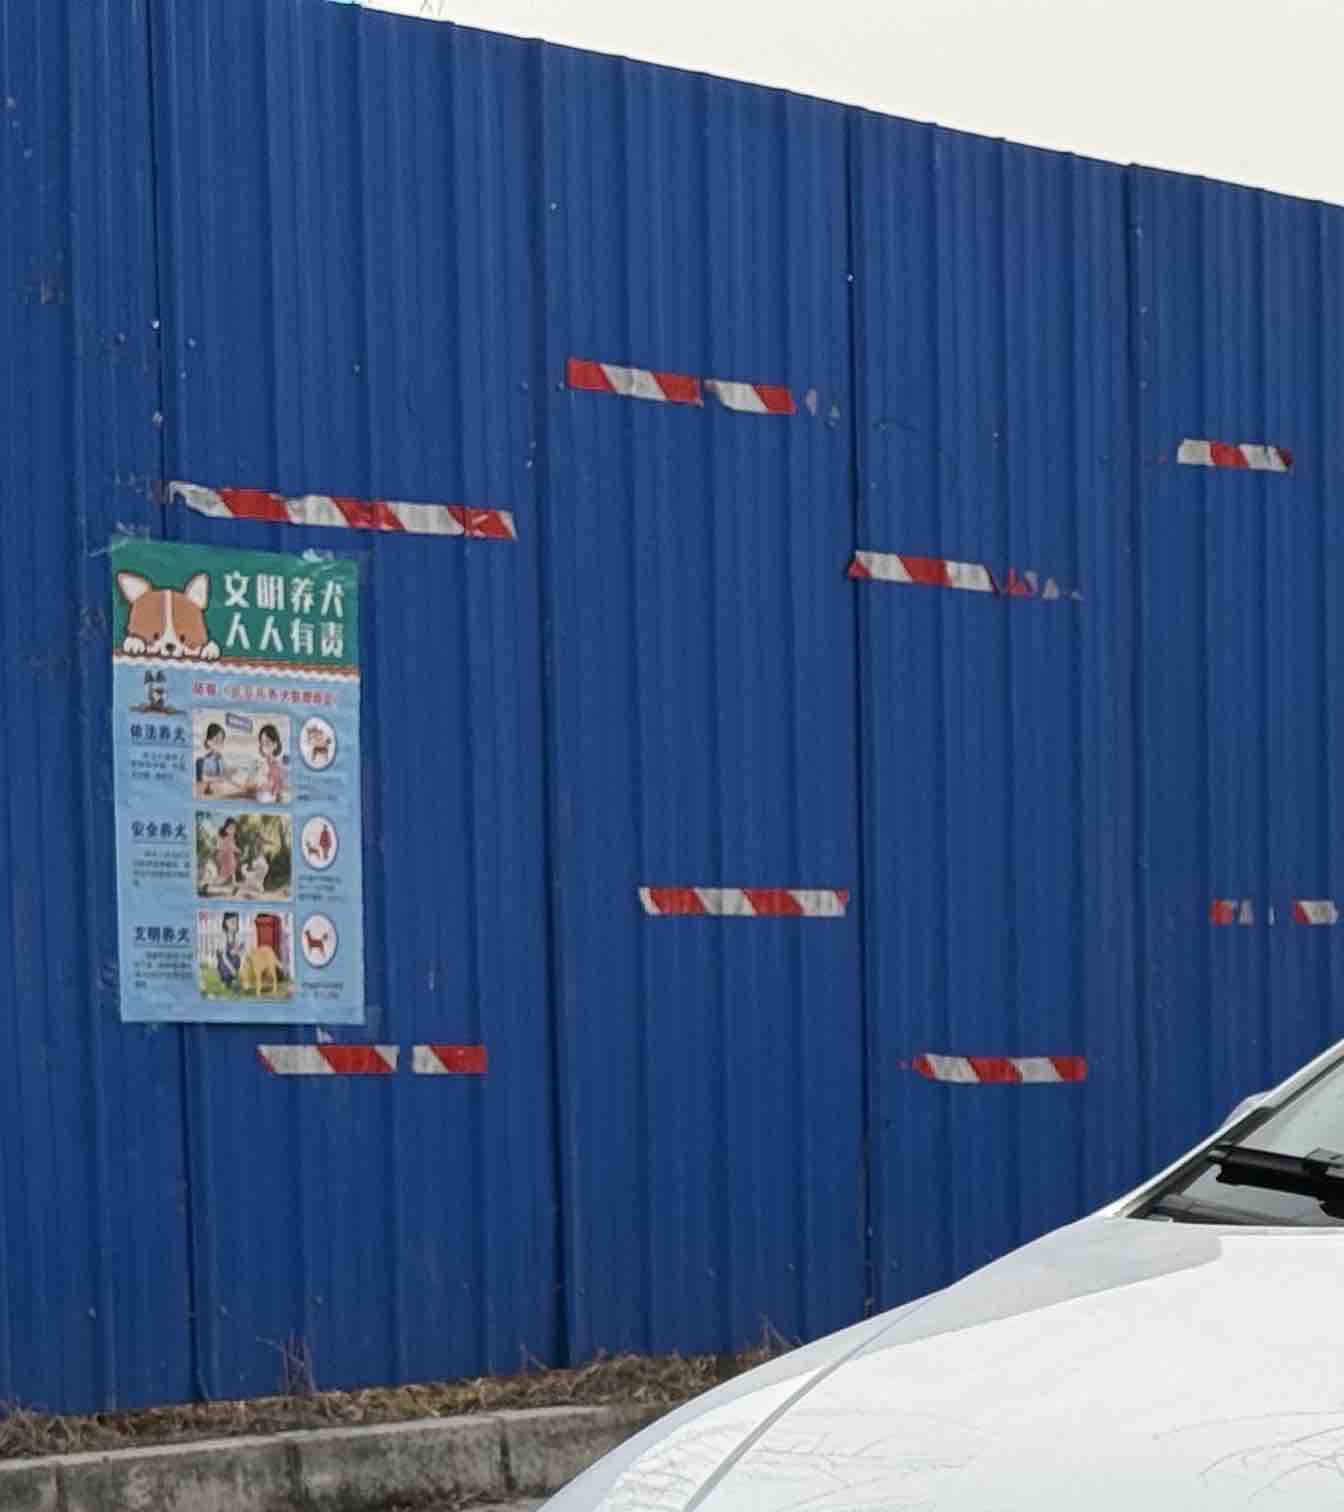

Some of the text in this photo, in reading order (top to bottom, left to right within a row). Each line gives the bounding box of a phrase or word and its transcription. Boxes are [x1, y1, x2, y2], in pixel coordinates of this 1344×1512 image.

[223, 570, 344, 617] 文明养犬
[225, 611, 344, 658] 人人有责
